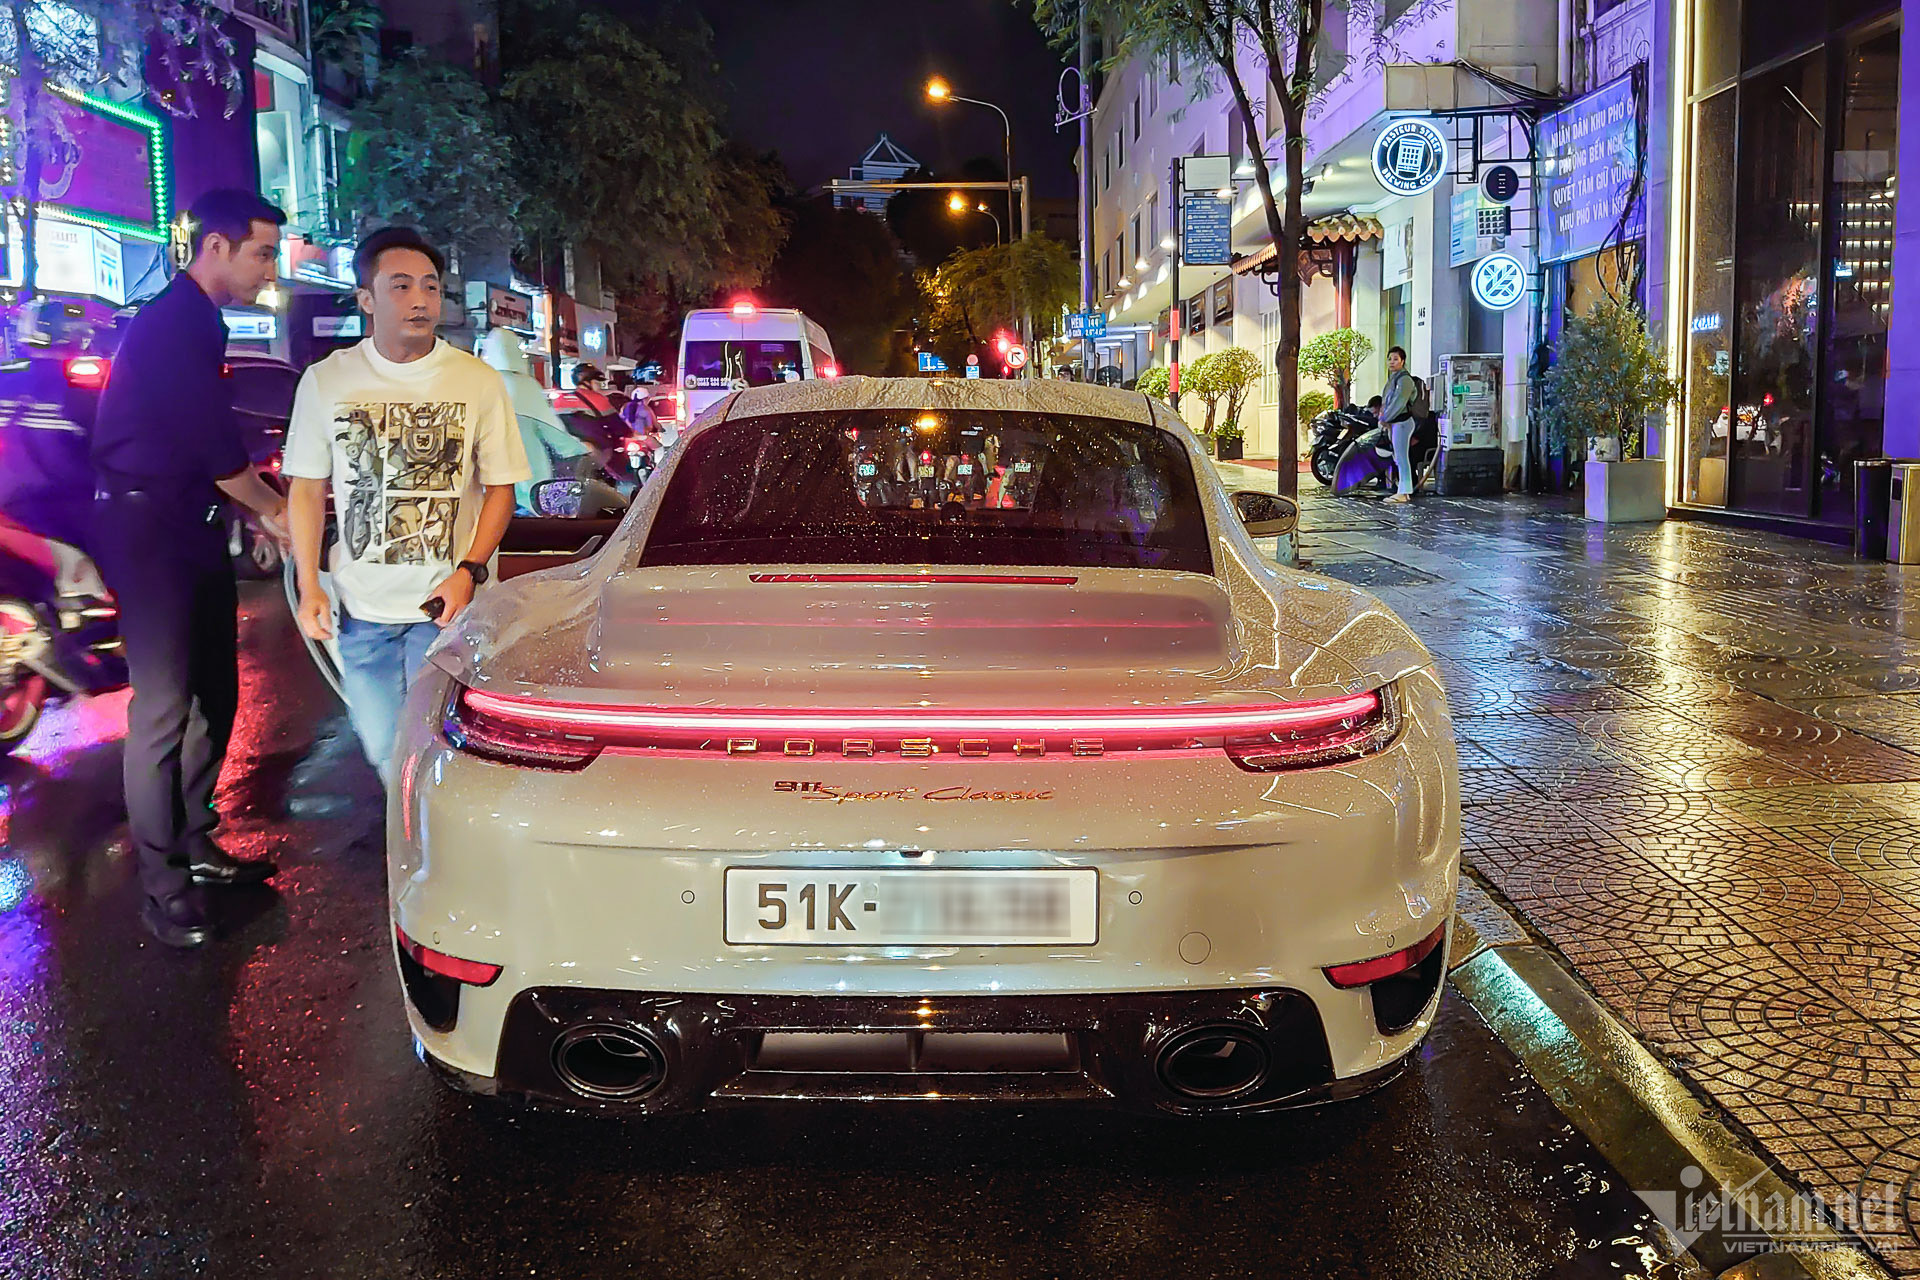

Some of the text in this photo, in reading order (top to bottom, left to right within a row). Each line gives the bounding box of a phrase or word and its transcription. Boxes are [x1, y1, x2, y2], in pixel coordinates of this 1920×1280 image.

[1572, 116, 1589, 140] DÂN
[1590, 109, 1606, 132] KHU
[1608, 94, 1624, 124] PHỐ
[1382, 124, 1442, 153] PASTEUR STREET
[1589, 136, 1605, 163] BẾN
[1382, 167, 1417, 190] BREWING
[1553, 177, 1575, 208] QUYẾT
[1578, 174, 1594, 196] TÂM
[1596, 165, 1609, 190] GIỮ
[1559, 213, 1574, 232] KHU
[1576, 200, 1590, 226] PHỐ
[1593, 199, 1608, 221] VĂN
[726, 736, 1105, 758] PORSCHE
[774, 780, 1055, 805] 911 Sport Classic
